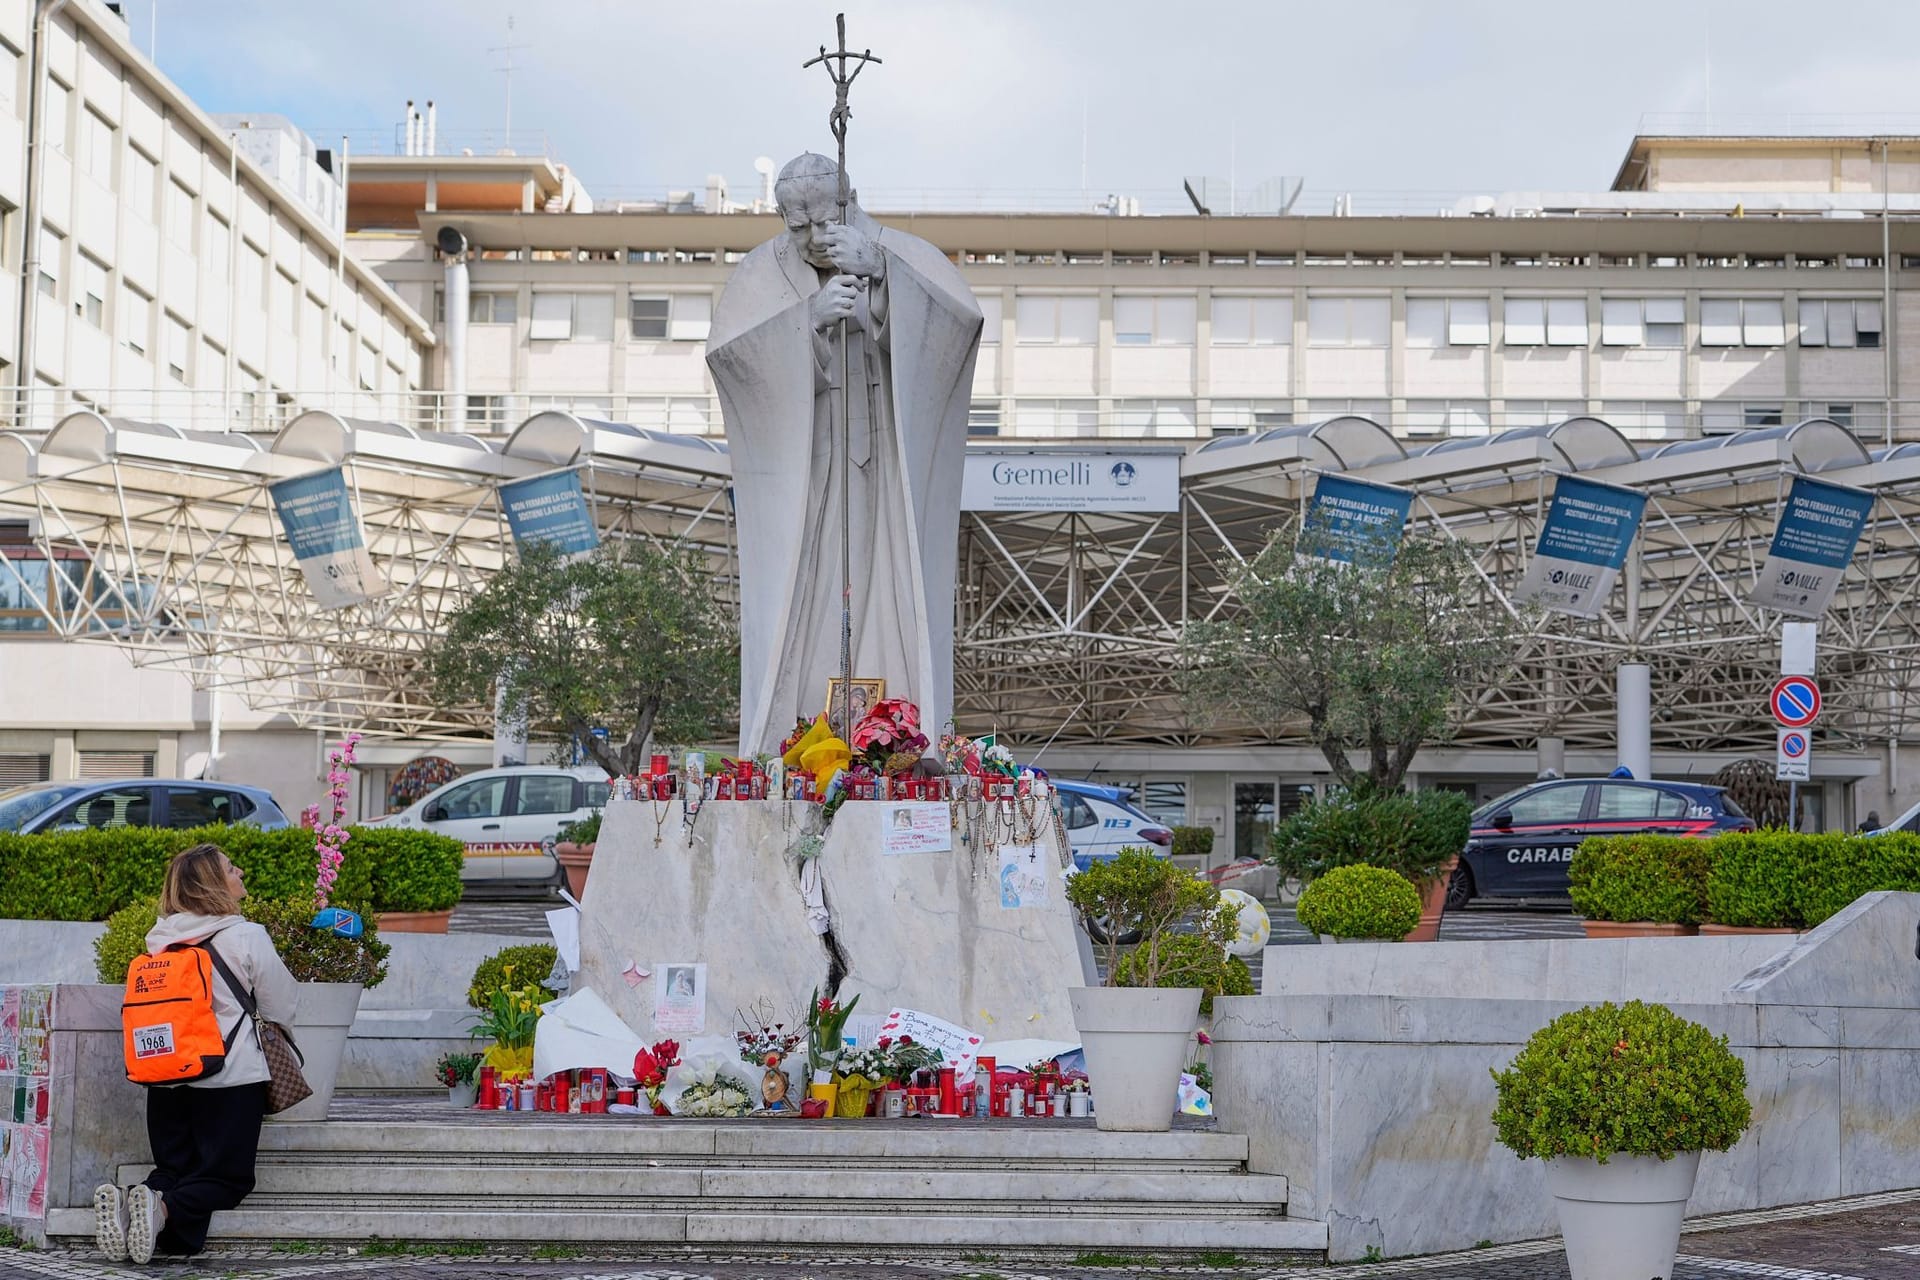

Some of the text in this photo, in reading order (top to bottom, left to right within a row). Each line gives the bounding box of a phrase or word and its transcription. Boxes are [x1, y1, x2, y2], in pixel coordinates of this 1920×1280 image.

[993, 461, 1090, 486] Gemelli
[511, 501, 525, 513] NON
[525, 496, 552, 508] FERMARE
[552, 493, 560, 502] LA
[543, 506, 552, 516] LA
[1320, 495, 1338, 507] NON
[1338, 498, 1370, 512] FERMARE
[1370, 504, 1379, 514] LA
[1558, 495, 1572, 506] NON
[1595, 503, 1603, 511] LA
[1793, 496, 1861, 521] NON FERMARE LA CURA,
[1352, 512, 1363, 522] LA
[1588, 512, 1596, 521] LA
[1793, 508, 1821, 522] SOSTIENI
[1821, 514, 1830, 524] LA
[1690, 805, 1713, 817] 112
[1103, 818, 1131, 828] 113
[1507, 847, 1574, 864] CARAB
[902, 1011, 929, 1027] Buona
[904, 1023, 922, 1037] Papa
[141, 1035, 165, 1051] 1968
